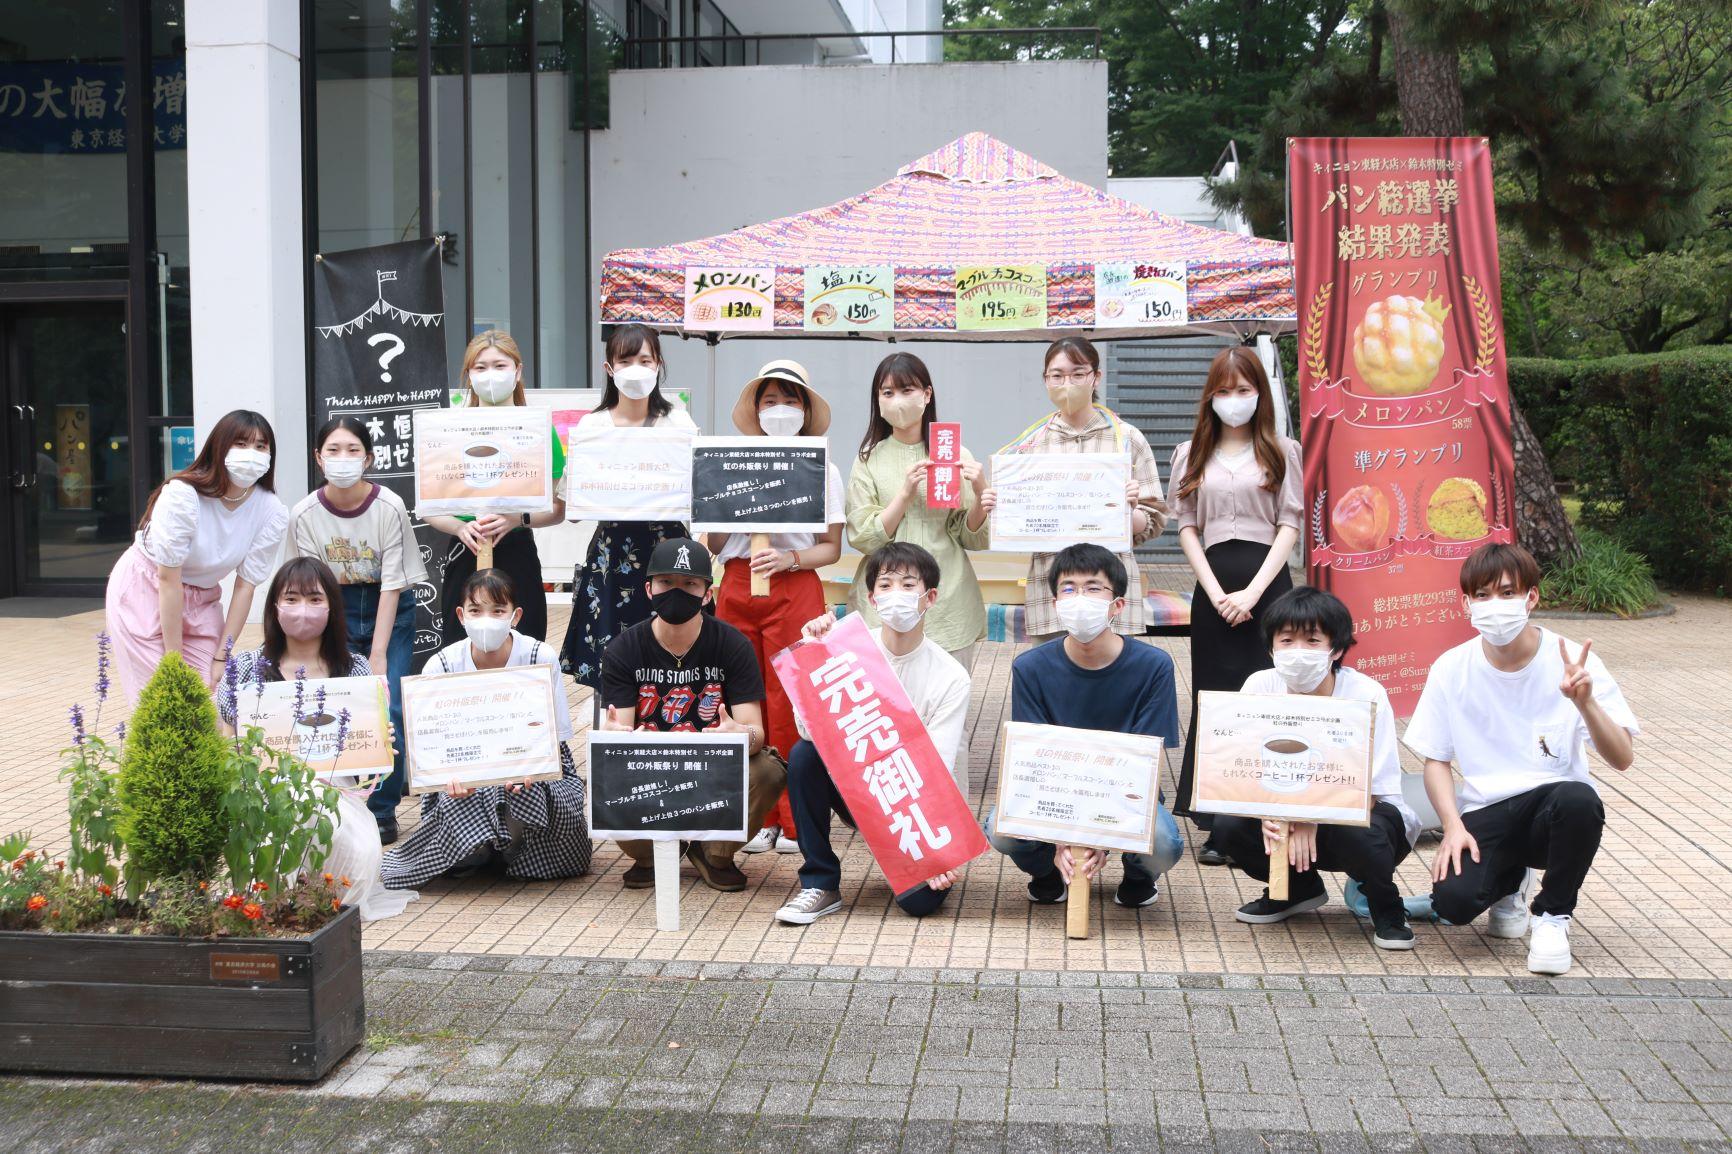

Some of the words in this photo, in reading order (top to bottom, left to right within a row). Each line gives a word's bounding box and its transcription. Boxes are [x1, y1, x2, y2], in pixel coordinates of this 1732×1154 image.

[71, 123, 186, 149] 東京経大学
[1321, 178, 1459, 216] パン総選挙
[1338, 221, 1451, 261] 結果発表
[693, 272, 773, 294] メロンパン
[820, 270, 878, 291] 塩パン
[1352, 268, 1438, 297] グランプリ
[728, 302, 762, 317] 130円
[847, 303, 877, 318] 150円
[981, 300, 1016, 317] 195円
[1145, 301, 1182, 318] 150円
[325, 396, 362, 407] Think
[364, 394, 394, 405] HAPPY
[397, 392, 409, 402] be
[410, 389, 442, 401] HAPPY
[1353, 397, 1452, 423] メロンパン
[723, 462, 769, 470] 虹の外販祭り
[934, 429, 953, 501] 完売御礼
[1354, 442, 1463, 473] 準グランプリ
[673, 545, 691, 570] A
[1335, 552, 1390, 567] クリームパン
[1373, 589, 1458, 614] 総投票数293票
[627, 761, 679, 771] 虹の外販祭り
[684, 761, 708, 771] 開催！
[809, 651, 952, 862] 完売御礼
[631, 780, 668, 795] 店長激推し！
